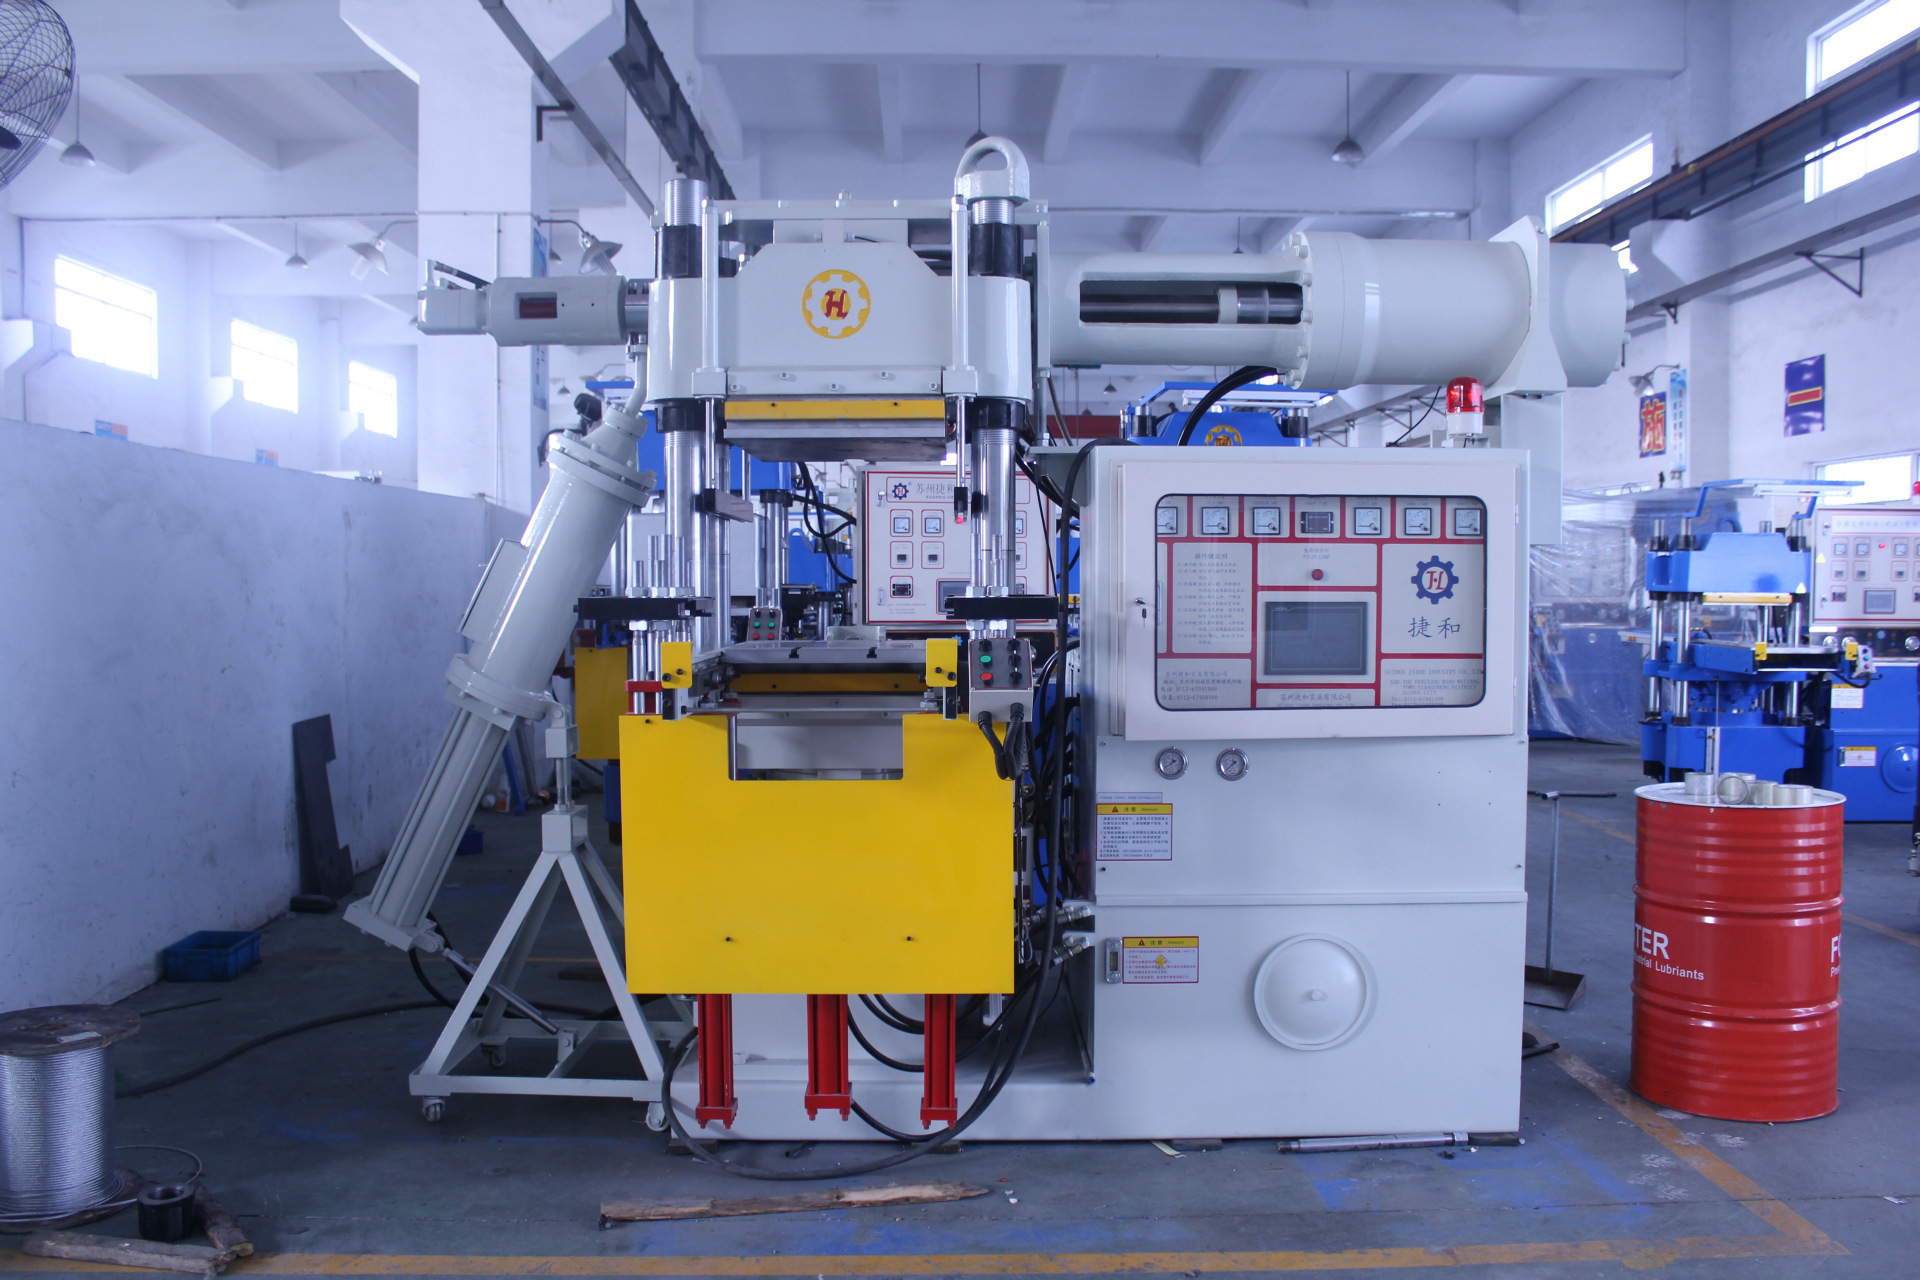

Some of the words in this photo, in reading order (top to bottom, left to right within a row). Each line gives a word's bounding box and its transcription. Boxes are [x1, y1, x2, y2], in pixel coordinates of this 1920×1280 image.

[1641, 398, 1667, 453] 施
[1407, 616, 1461, 640] 捷和
[1280, 693, 1352, 702] 苏州捷和实业有限公司
[1655, 961, 1705, 981] Lubriants
